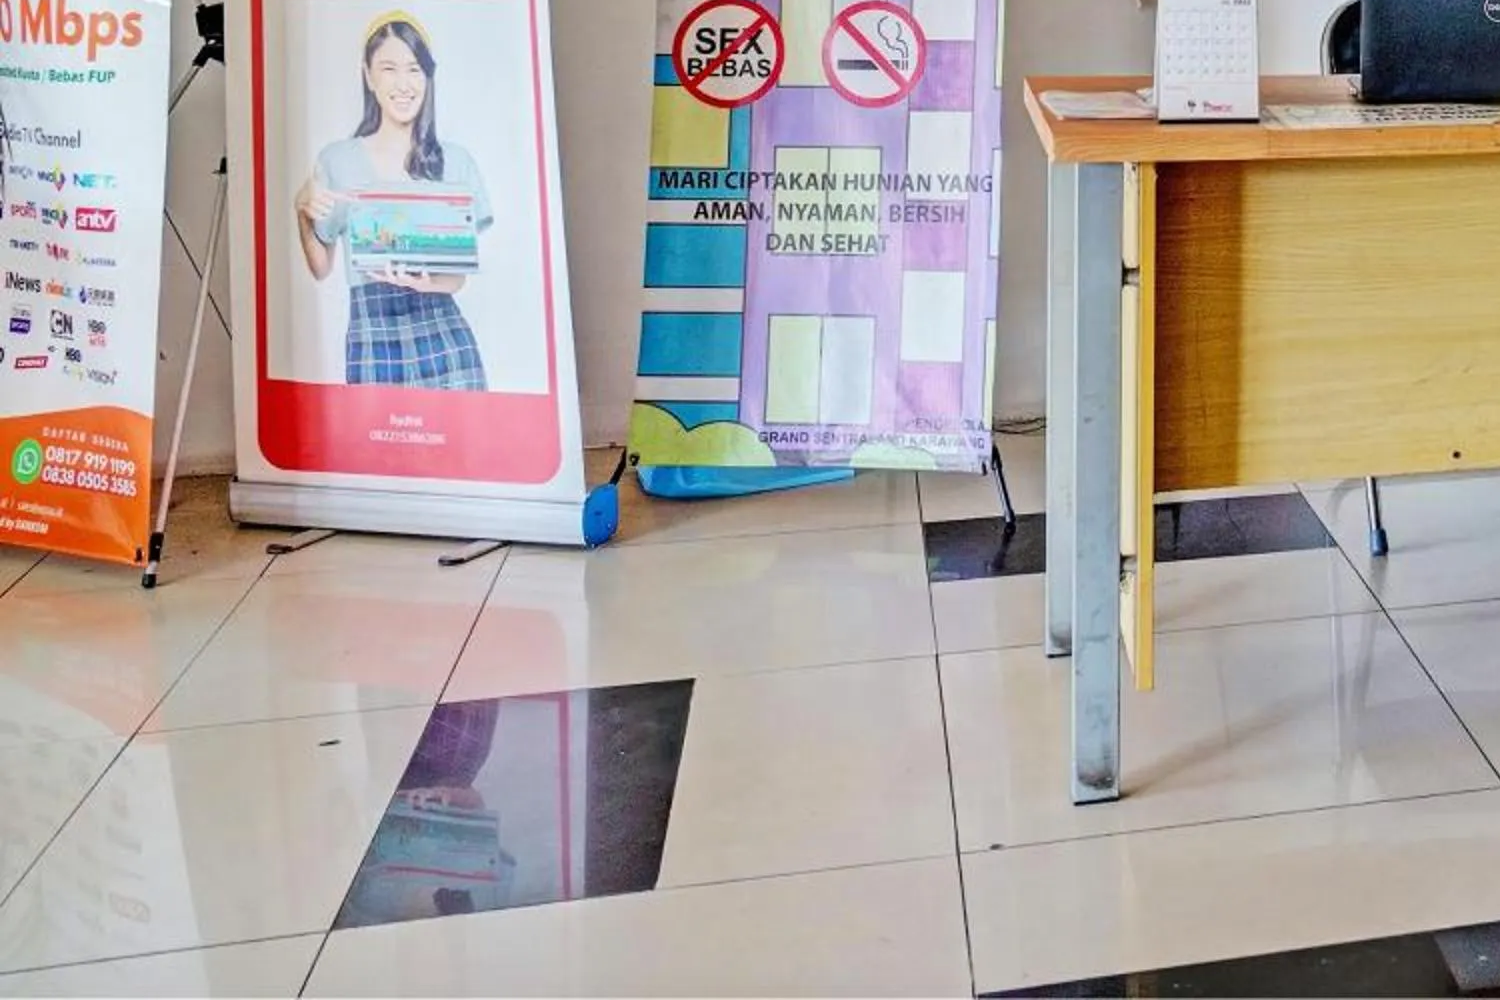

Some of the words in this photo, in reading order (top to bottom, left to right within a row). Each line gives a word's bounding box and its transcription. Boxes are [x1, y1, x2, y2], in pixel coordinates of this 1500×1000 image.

[695, 27, 764, 55] SEX
[48, 68, 84, 83] Bebas
[88, 69, 116, 83] FUP
[34, 128, 81, 148] Channel
[658, 171, 718, 189] MARI
[725, 172, 836, 191] CIPTAKAN
[844, 173, 931, 192] HUNIAN
[937, 174, 993, 193] YANG
[693, 202, 770, 222] AMAN,
[778, 203, 881, 223] NYAMAN,
[889, 205, 965, 222] BERSIH
[766, 233, 815, 251] DAN
[821, 234, 890, 253] SEHAT
[5, 271, 41, 293] iNews
[759, 431, 809, 443] GRAND
[45, 445, 82, 465] 0817
[84, 452, 108, 471] 919
